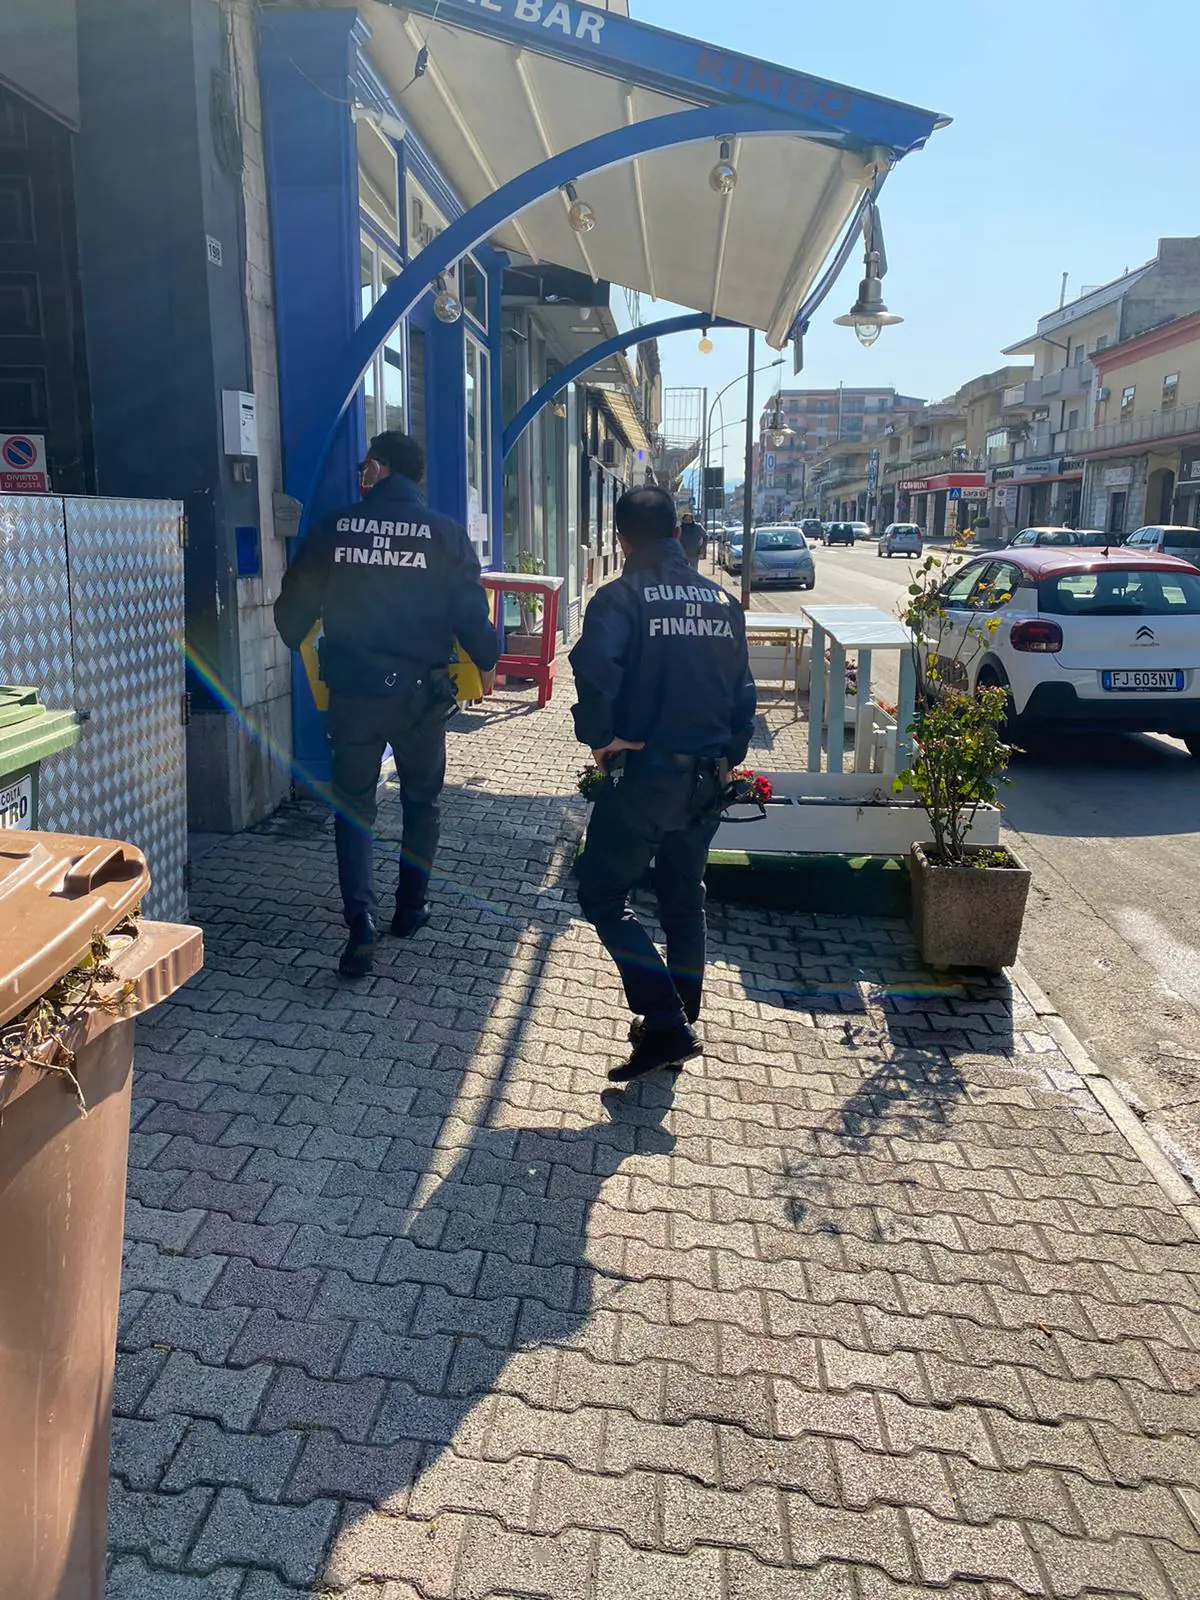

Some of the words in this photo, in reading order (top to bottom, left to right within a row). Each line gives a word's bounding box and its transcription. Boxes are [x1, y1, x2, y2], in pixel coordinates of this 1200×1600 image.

[514, 0, 605, 44] BAR
[336, 517, 432, 539] GUARDIA
[372, 536, 391, 549] DI
[334, 547, 428, 569] FINANZA
[685, 603, 702, 617] DI
[649, 617, 734, 639] FINANZA
[1112, 673, 1129, 686] FJ
[1134, 673, 1175, 686] 603NV
